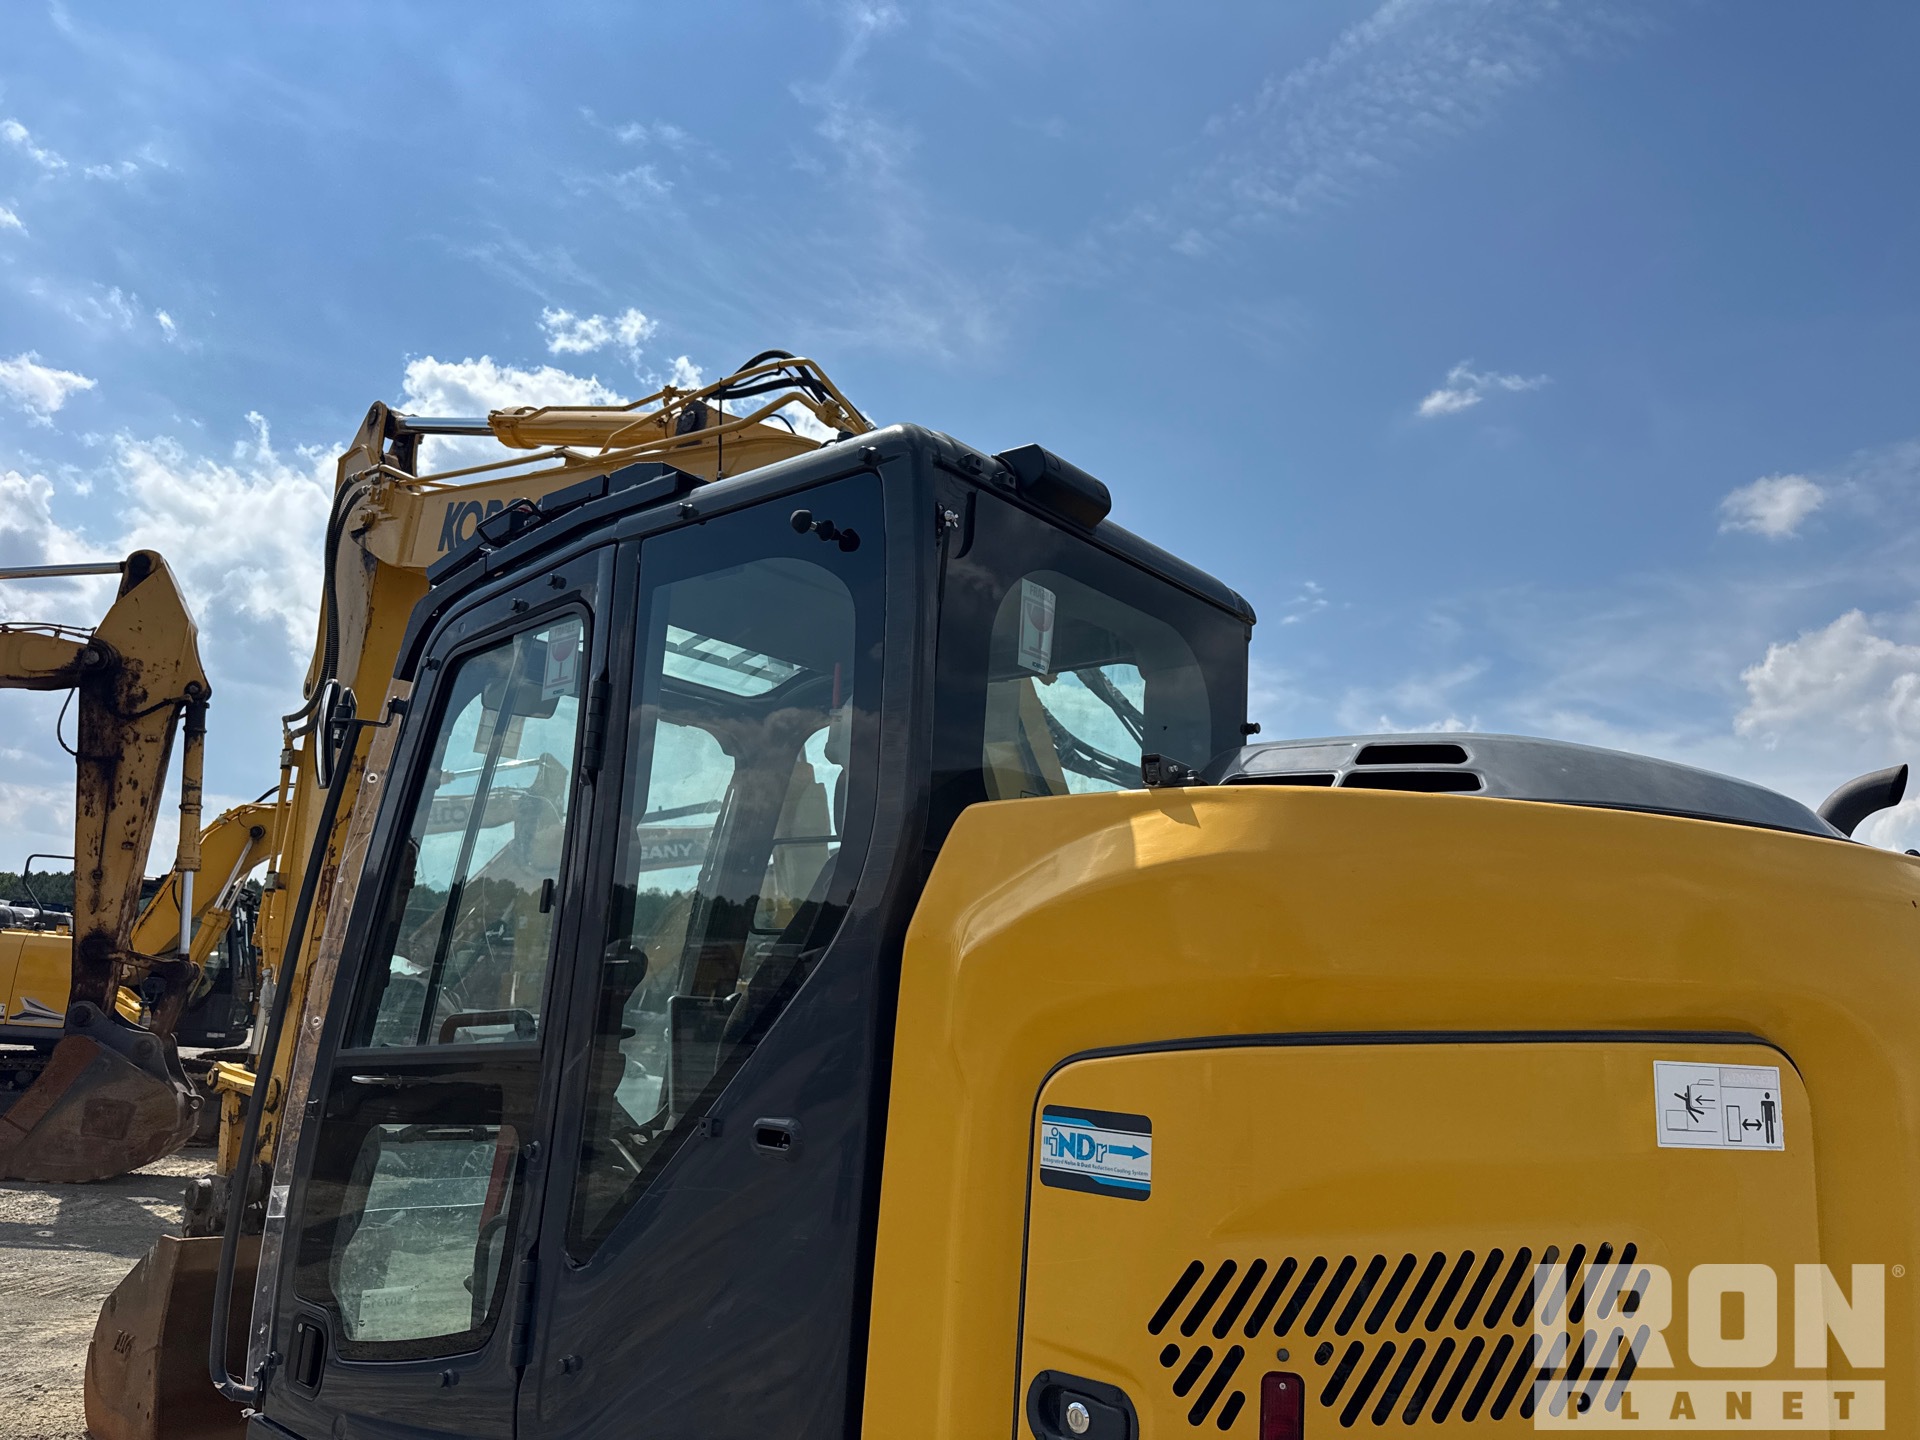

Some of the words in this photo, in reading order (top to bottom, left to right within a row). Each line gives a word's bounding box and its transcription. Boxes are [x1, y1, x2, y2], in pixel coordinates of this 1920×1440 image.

[1064, 1159, 1076, 1167] Noise
[1081, 1161, 1091, 1169] Dust
[1092, 1164, 1113, 1172] Reduction
[1114, 1167, 1131, 1175] Cooling
[1132, 1169, 1149, 1177] System
